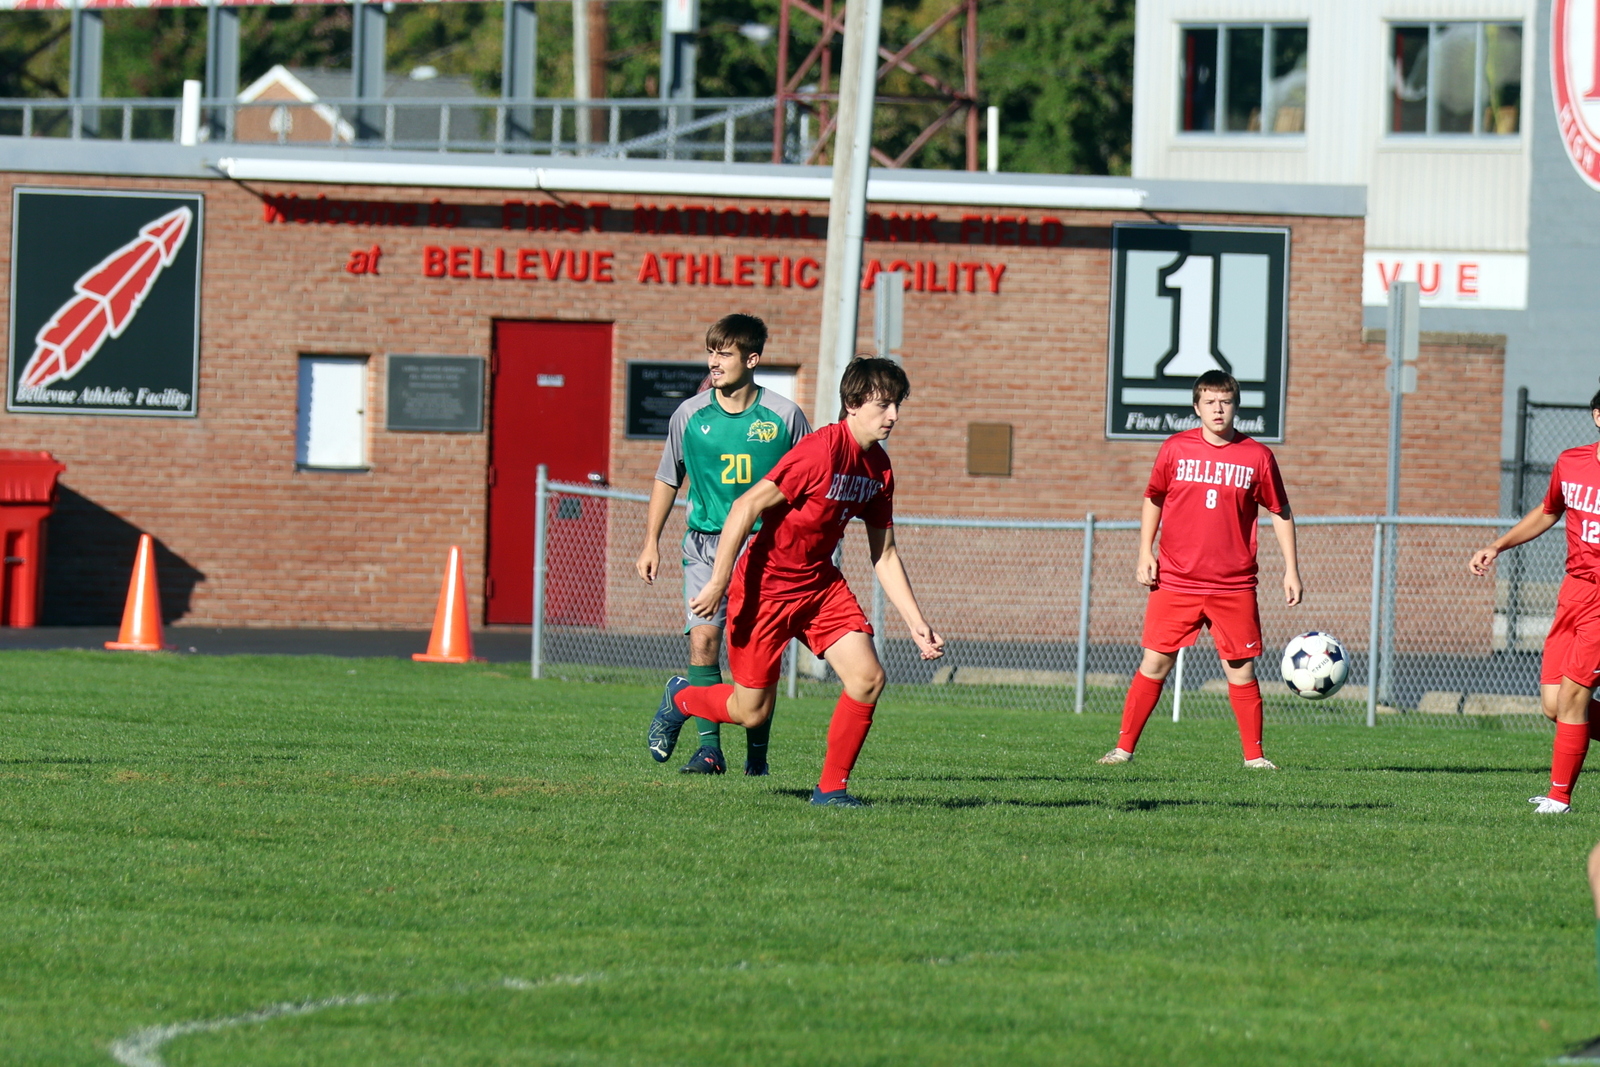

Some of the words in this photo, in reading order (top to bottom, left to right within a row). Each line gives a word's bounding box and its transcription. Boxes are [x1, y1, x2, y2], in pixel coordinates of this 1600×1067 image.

[262, 191, 418, 227] Welcome
[428, 198, 462, 229] to
[502, 200, 611, 233] FIRST
[632, 203, 819, 240] NATIONAL
[864, 211, 938, 244] ANK
[960, 213, 1065, 247] FIELD
[345, 244, 380, 276] at
[422, 244, 615, 283] BELLEVUE
[637, 252, 820, 290] ATHLETIC
[861, 259, 1007, 295] ACILITY
[15, 384, 78, 404] Bellevue
[78, 386, 134, 406] Athletic
[135, 387, 191, 411] Facility
[1124, 411, 1161, 431] First
[1161, 412, 1203, 432] Natio
[720, 453, 752, 484] 20
[1175, 458, 1255, 490] BELLEVUE
[1205, 488, 1218, 510] 8
[1580, 519, 1600, 544] 12
